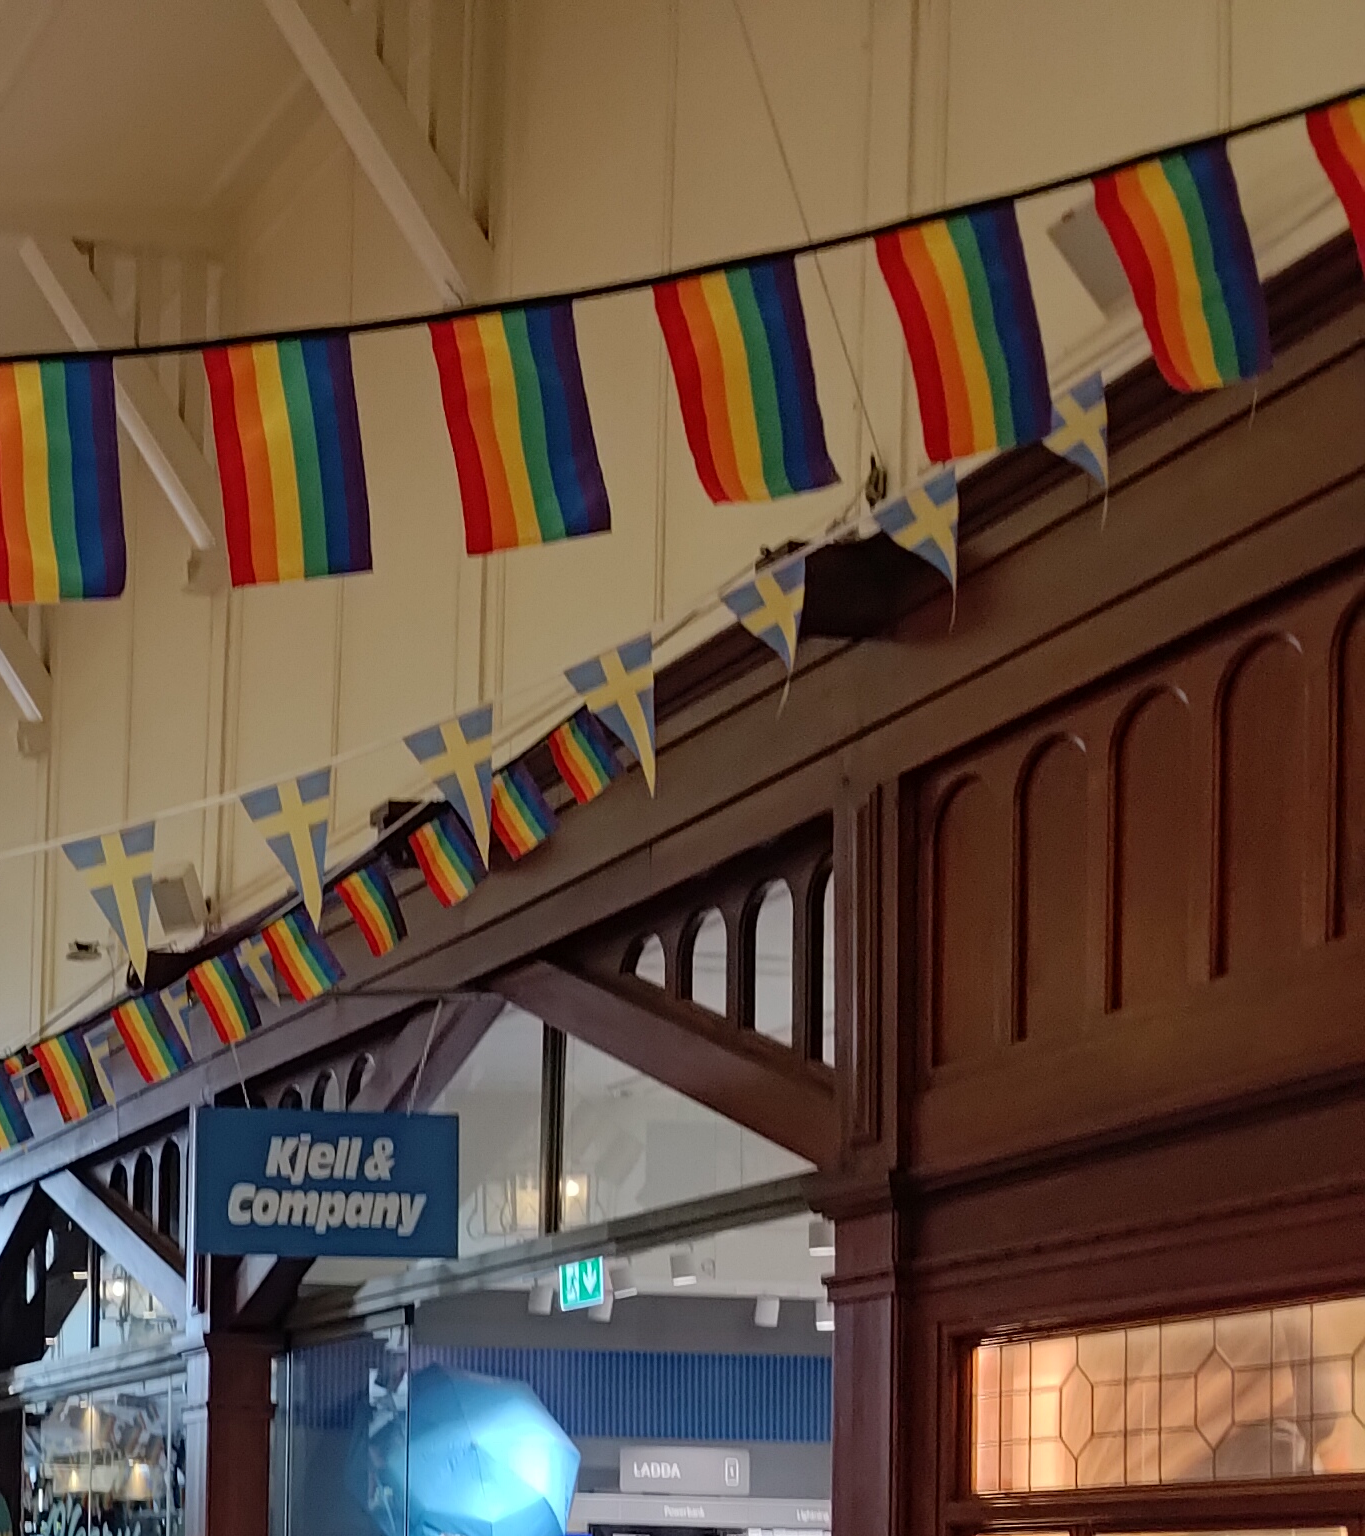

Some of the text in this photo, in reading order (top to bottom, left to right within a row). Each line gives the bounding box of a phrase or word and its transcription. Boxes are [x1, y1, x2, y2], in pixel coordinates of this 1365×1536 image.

[265, 1132, 395, 1186] Kjell &
[227, 1181, 427, 1238] Company
[633, 1461, 681, 1479] LADDA
